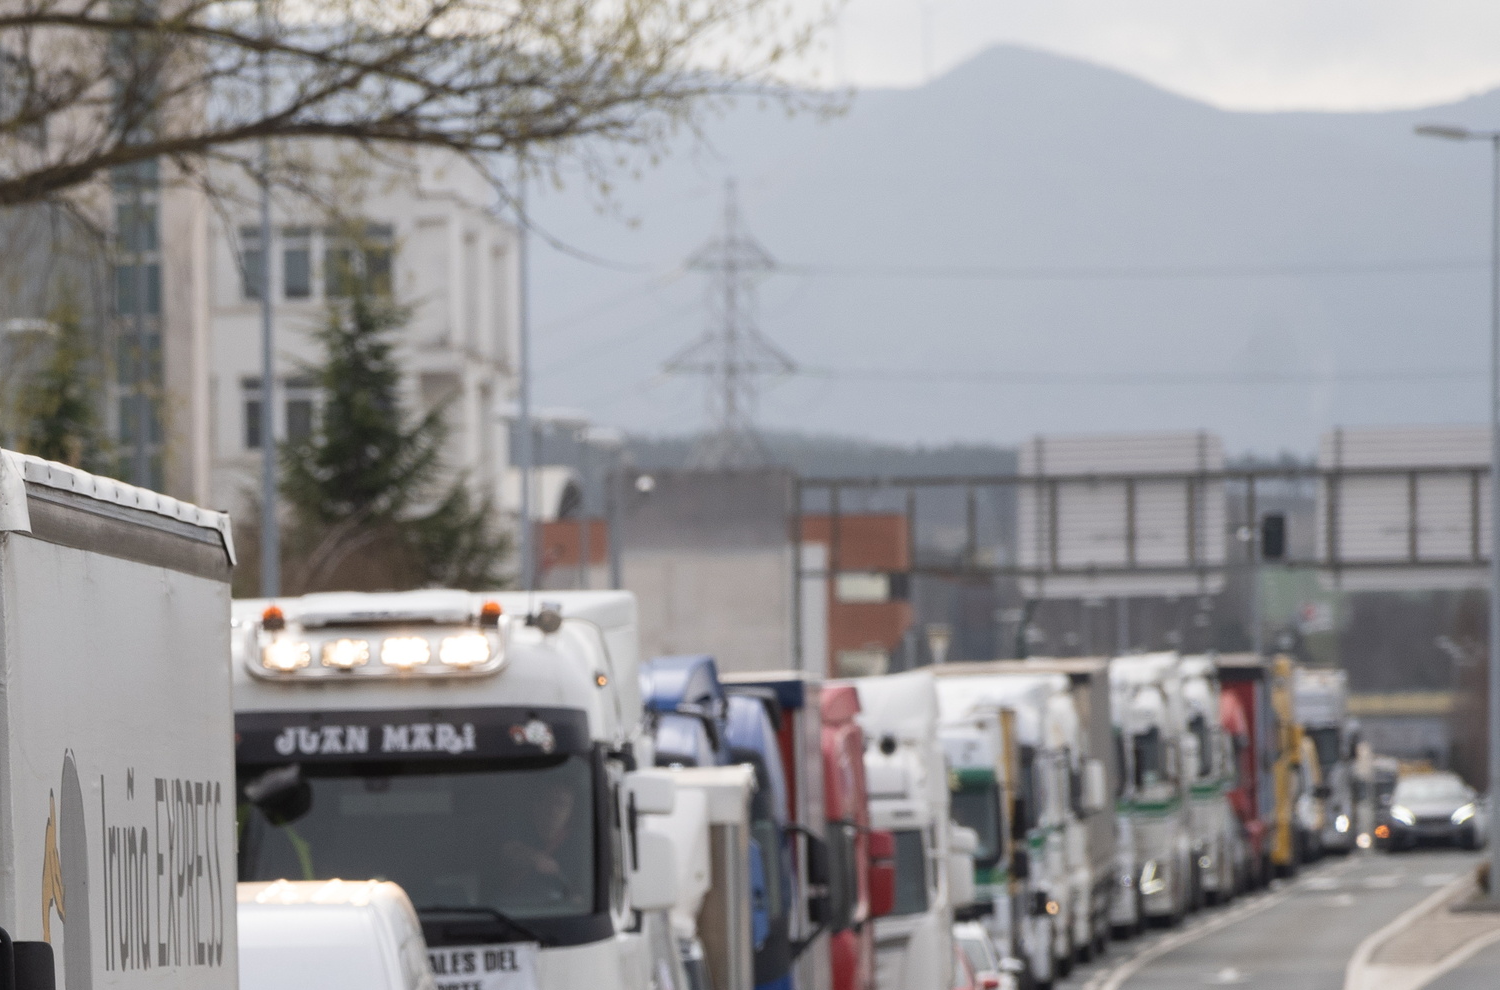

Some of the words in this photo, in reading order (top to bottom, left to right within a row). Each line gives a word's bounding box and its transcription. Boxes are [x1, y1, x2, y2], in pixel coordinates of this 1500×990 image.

[274, 725, 369, 755] JUAN
[155, 777, 224, 968] EXPRESS
[483, 949, 518, 972] DEL
